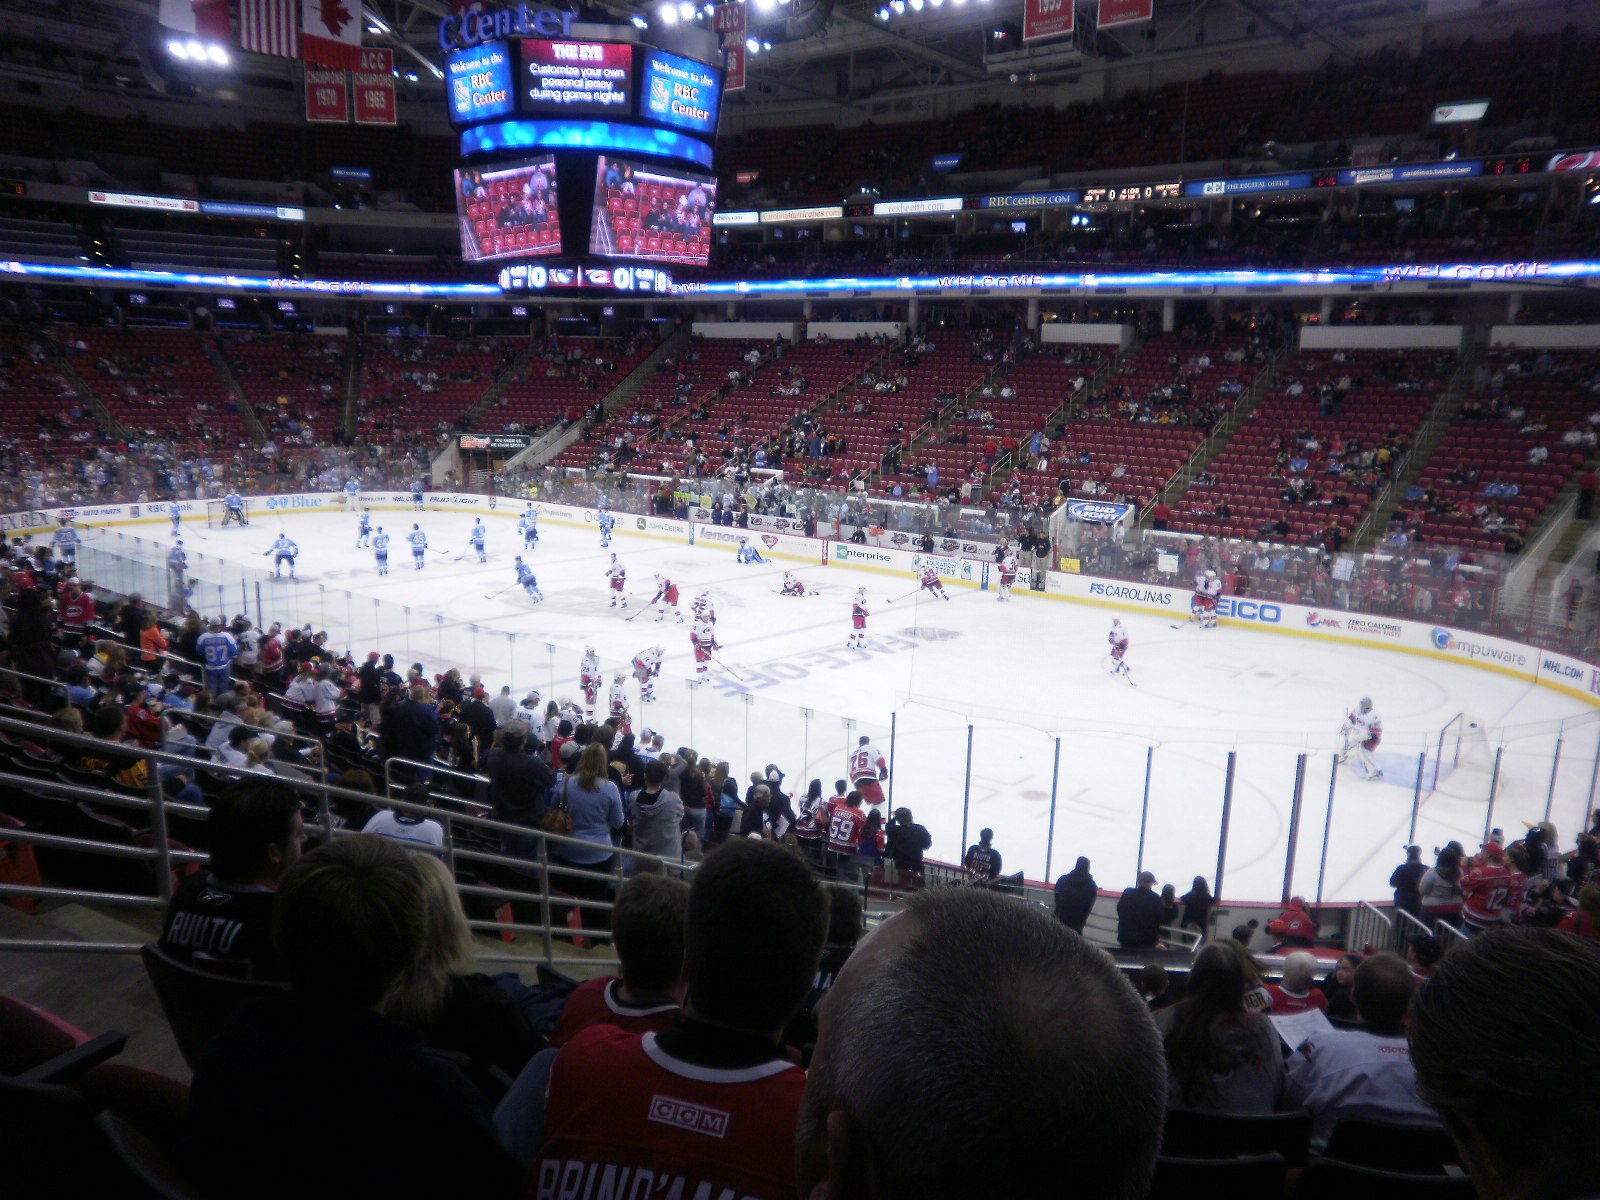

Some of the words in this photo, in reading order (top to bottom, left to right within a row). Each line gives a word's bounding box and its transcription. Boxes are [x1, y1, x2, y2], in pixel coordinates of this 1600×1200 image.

[461, 2, 579, 43] Center
[552, 44, 577, 60] THE
[578, 44, 604, 60] EYE
[361, 52, 386, 70] ACC
[450, 60, 480, 73] Welcome
[481, 57, 490, 67] to
[490, 53, 502, 65] the
[529, 63, 579, 77] Customize
[581, 67, 602, 79] your
[603, 68, 624, 77] own
[652, 59, 688, 79] Welcome
[690, 72, 698, 83] to
[700, 72, 713, 86] the
[470, 72, 493, 88] RBC
[541, 77, 583, 90] personal
[585, 79, 612, 91] jersey
[473, 90, 506, 106] Center
[530, 88, 560, 102] during
[562, 90, 591, 102] game
[593, 89, 624, 102] nights!
[673, 83, 699, 101] RBC
[672, 100, 709, 121] Center
[888, 200, 945, 214] rexhealth.com
[147, 503, 165, 512] RBC
[292, 496, 322, 507] Blue
[1084, 505, 1116, 514] BUD
[1079, 511, 1120, 520] LIGHT
[700, 527, 749, 543] lenovo
[841, 547, 891, 562] enterprise
[1191, 596, 1281, 623] EICO
[1347, 619, 1366, 627] ZERO
[1368, 621, 1402, 632] CALORIES
[1543, 659, 1585, 680] NHL.COM
[830, 816, 854, 841] 59
[654, 1102, 723, 1133] CCM
